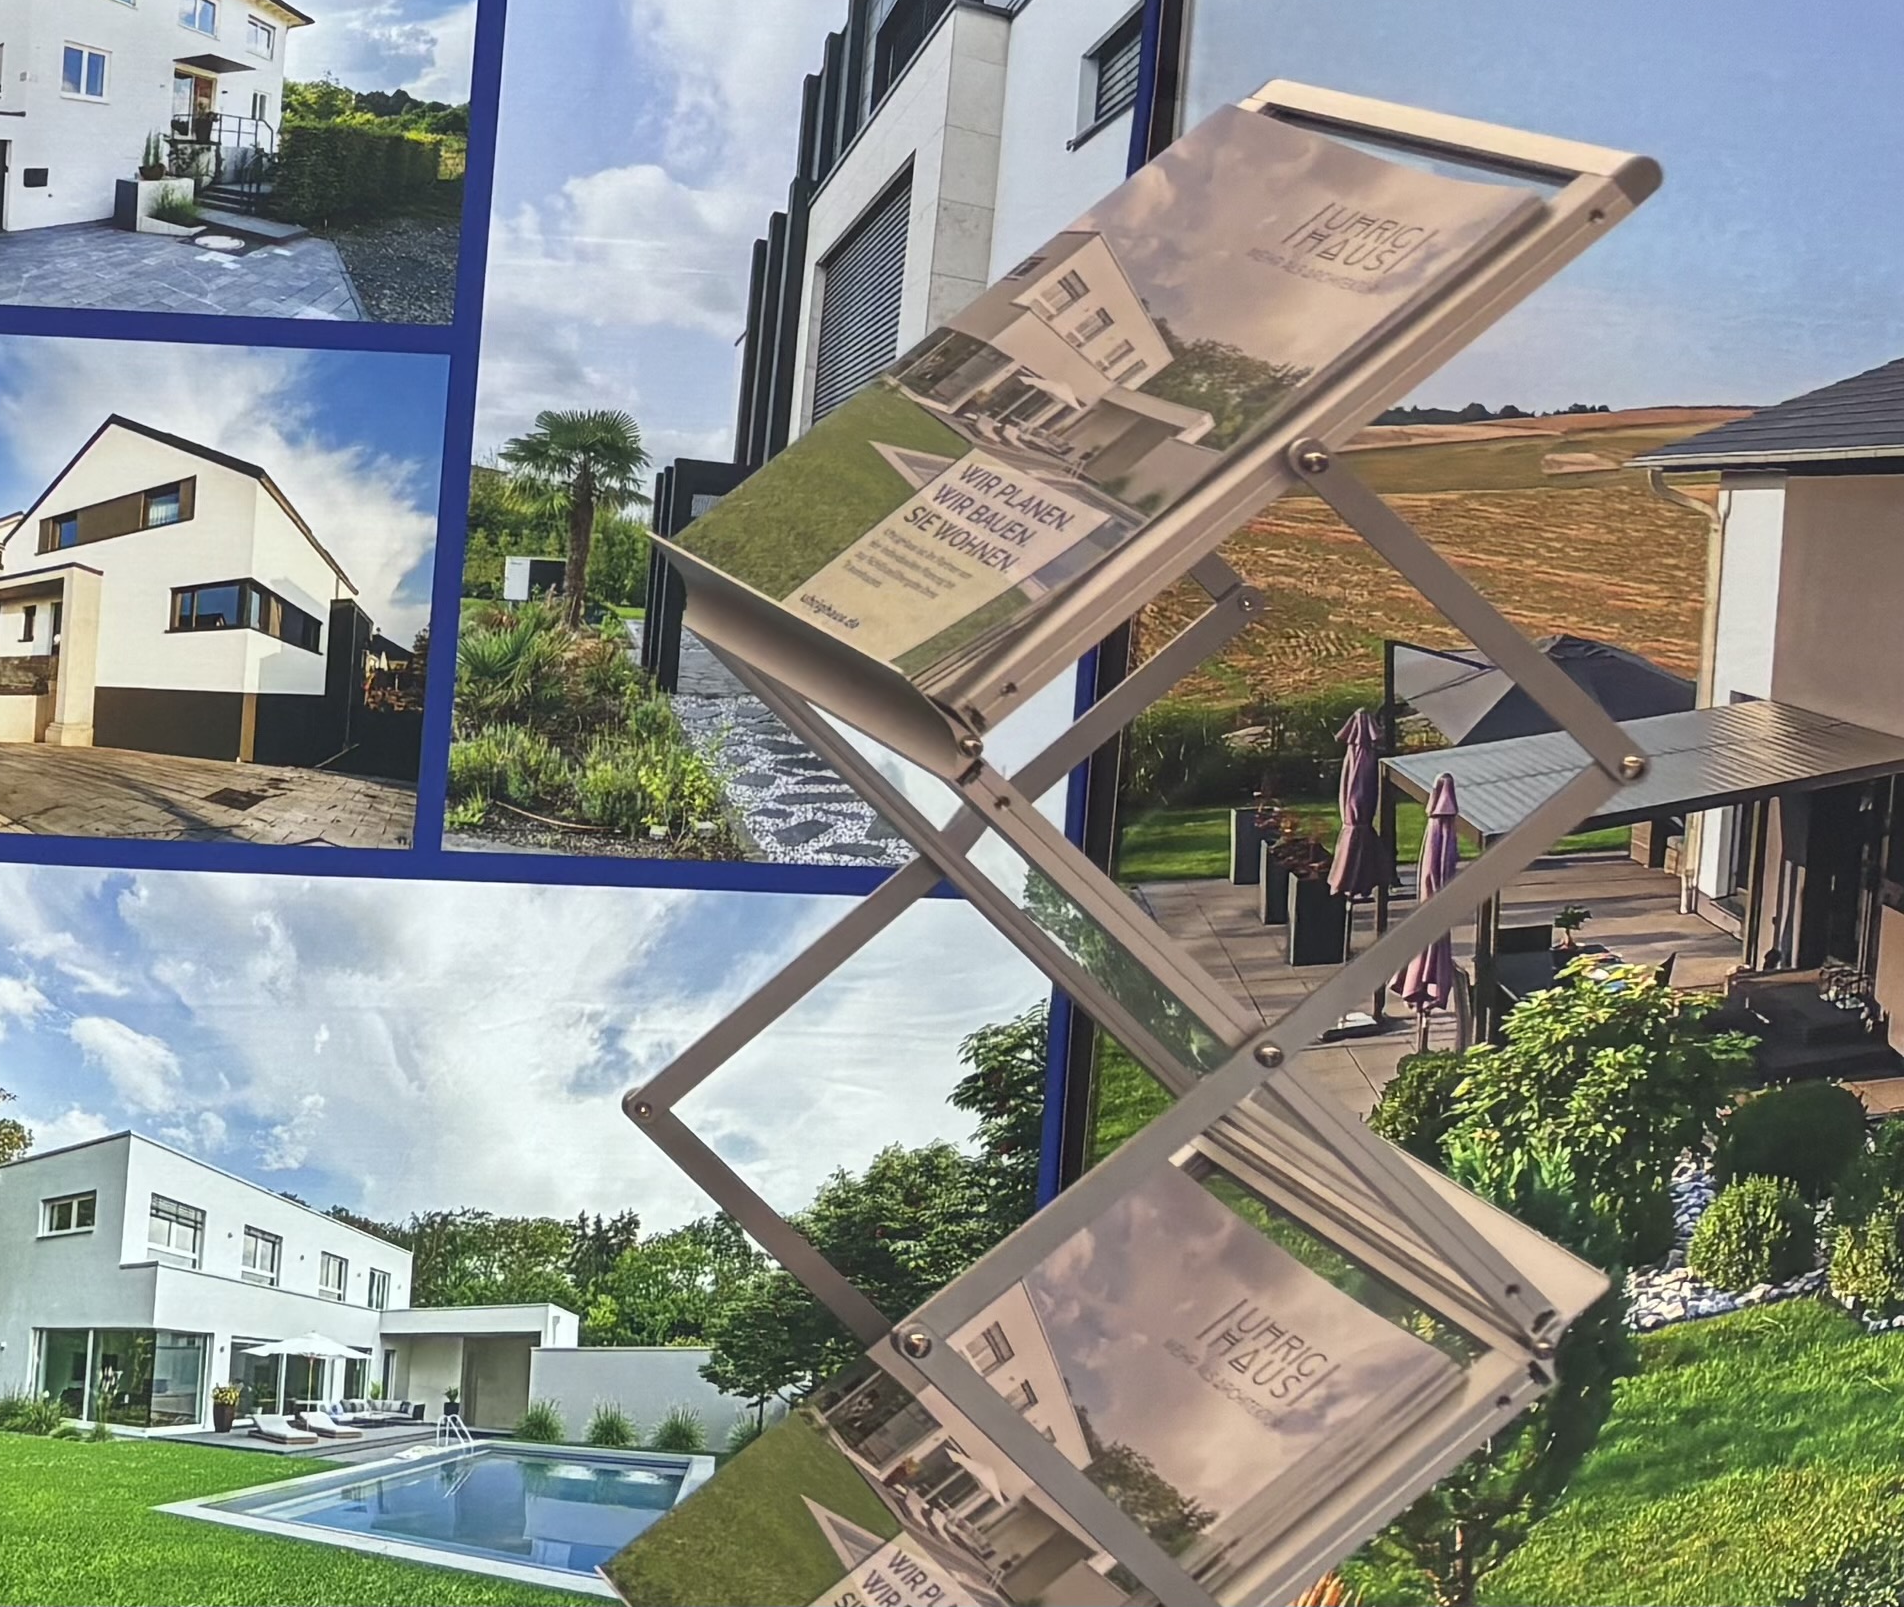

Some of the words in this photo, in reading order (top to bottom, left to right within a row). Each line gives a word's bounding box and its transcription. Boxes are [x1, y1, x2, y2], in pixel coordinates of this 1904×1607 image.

[932, 483, 975, 515] WIR
[969, 500, 1037, 548] BAUEN.
[959, 463, 1003, 494] WIR
[994, 483, 1075, 532] PLANEN.
[904, 505, 939, 532] SIE
[933, 518, 1020, 574] WOHNEN.
[887, 1549, 927, 1593] WIR
[917, 1582, 958, 1607] PL
